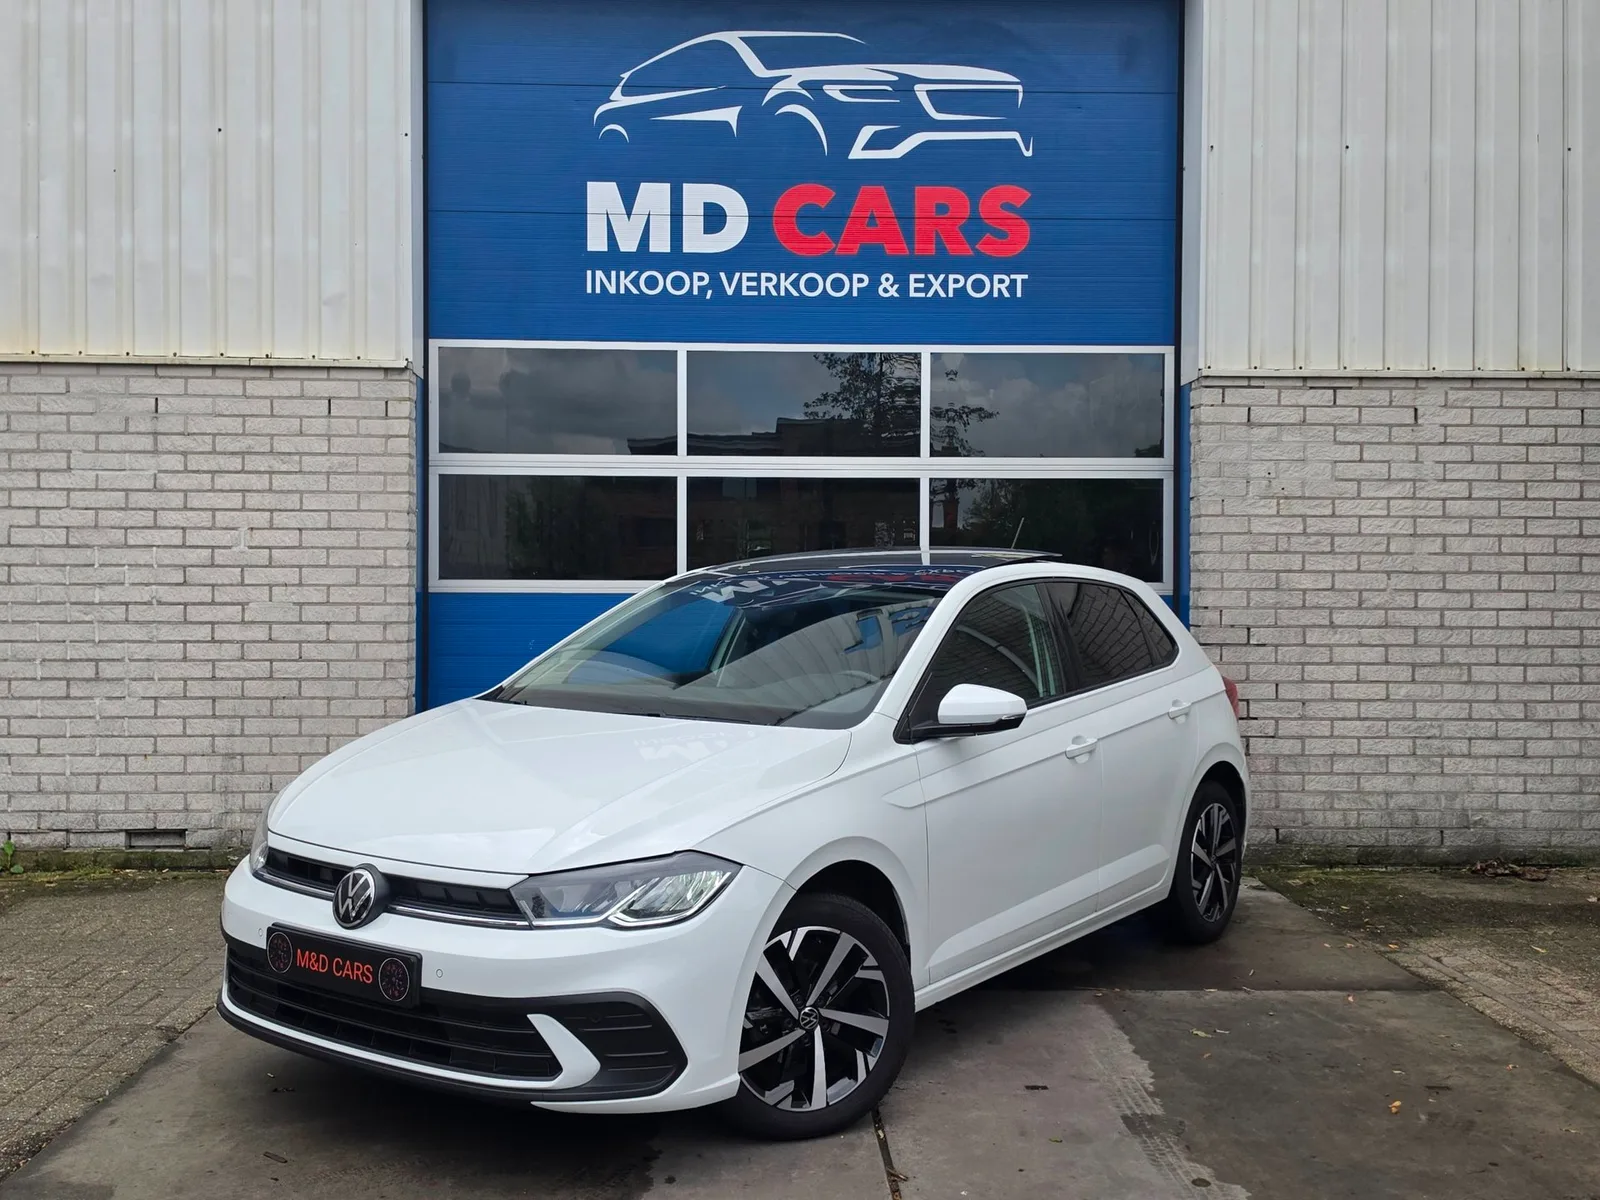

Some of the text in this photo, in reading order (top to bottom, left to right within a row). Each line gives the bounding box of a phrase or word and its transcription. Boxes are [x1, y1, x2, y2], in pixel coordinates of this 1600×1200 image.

[586, 181, 1032, 257] MD CARS
[586, 270, 1029, 299] INKOOP, VERKOOP & EXPORT
[296, 948, 373, 984] M&D CARS
